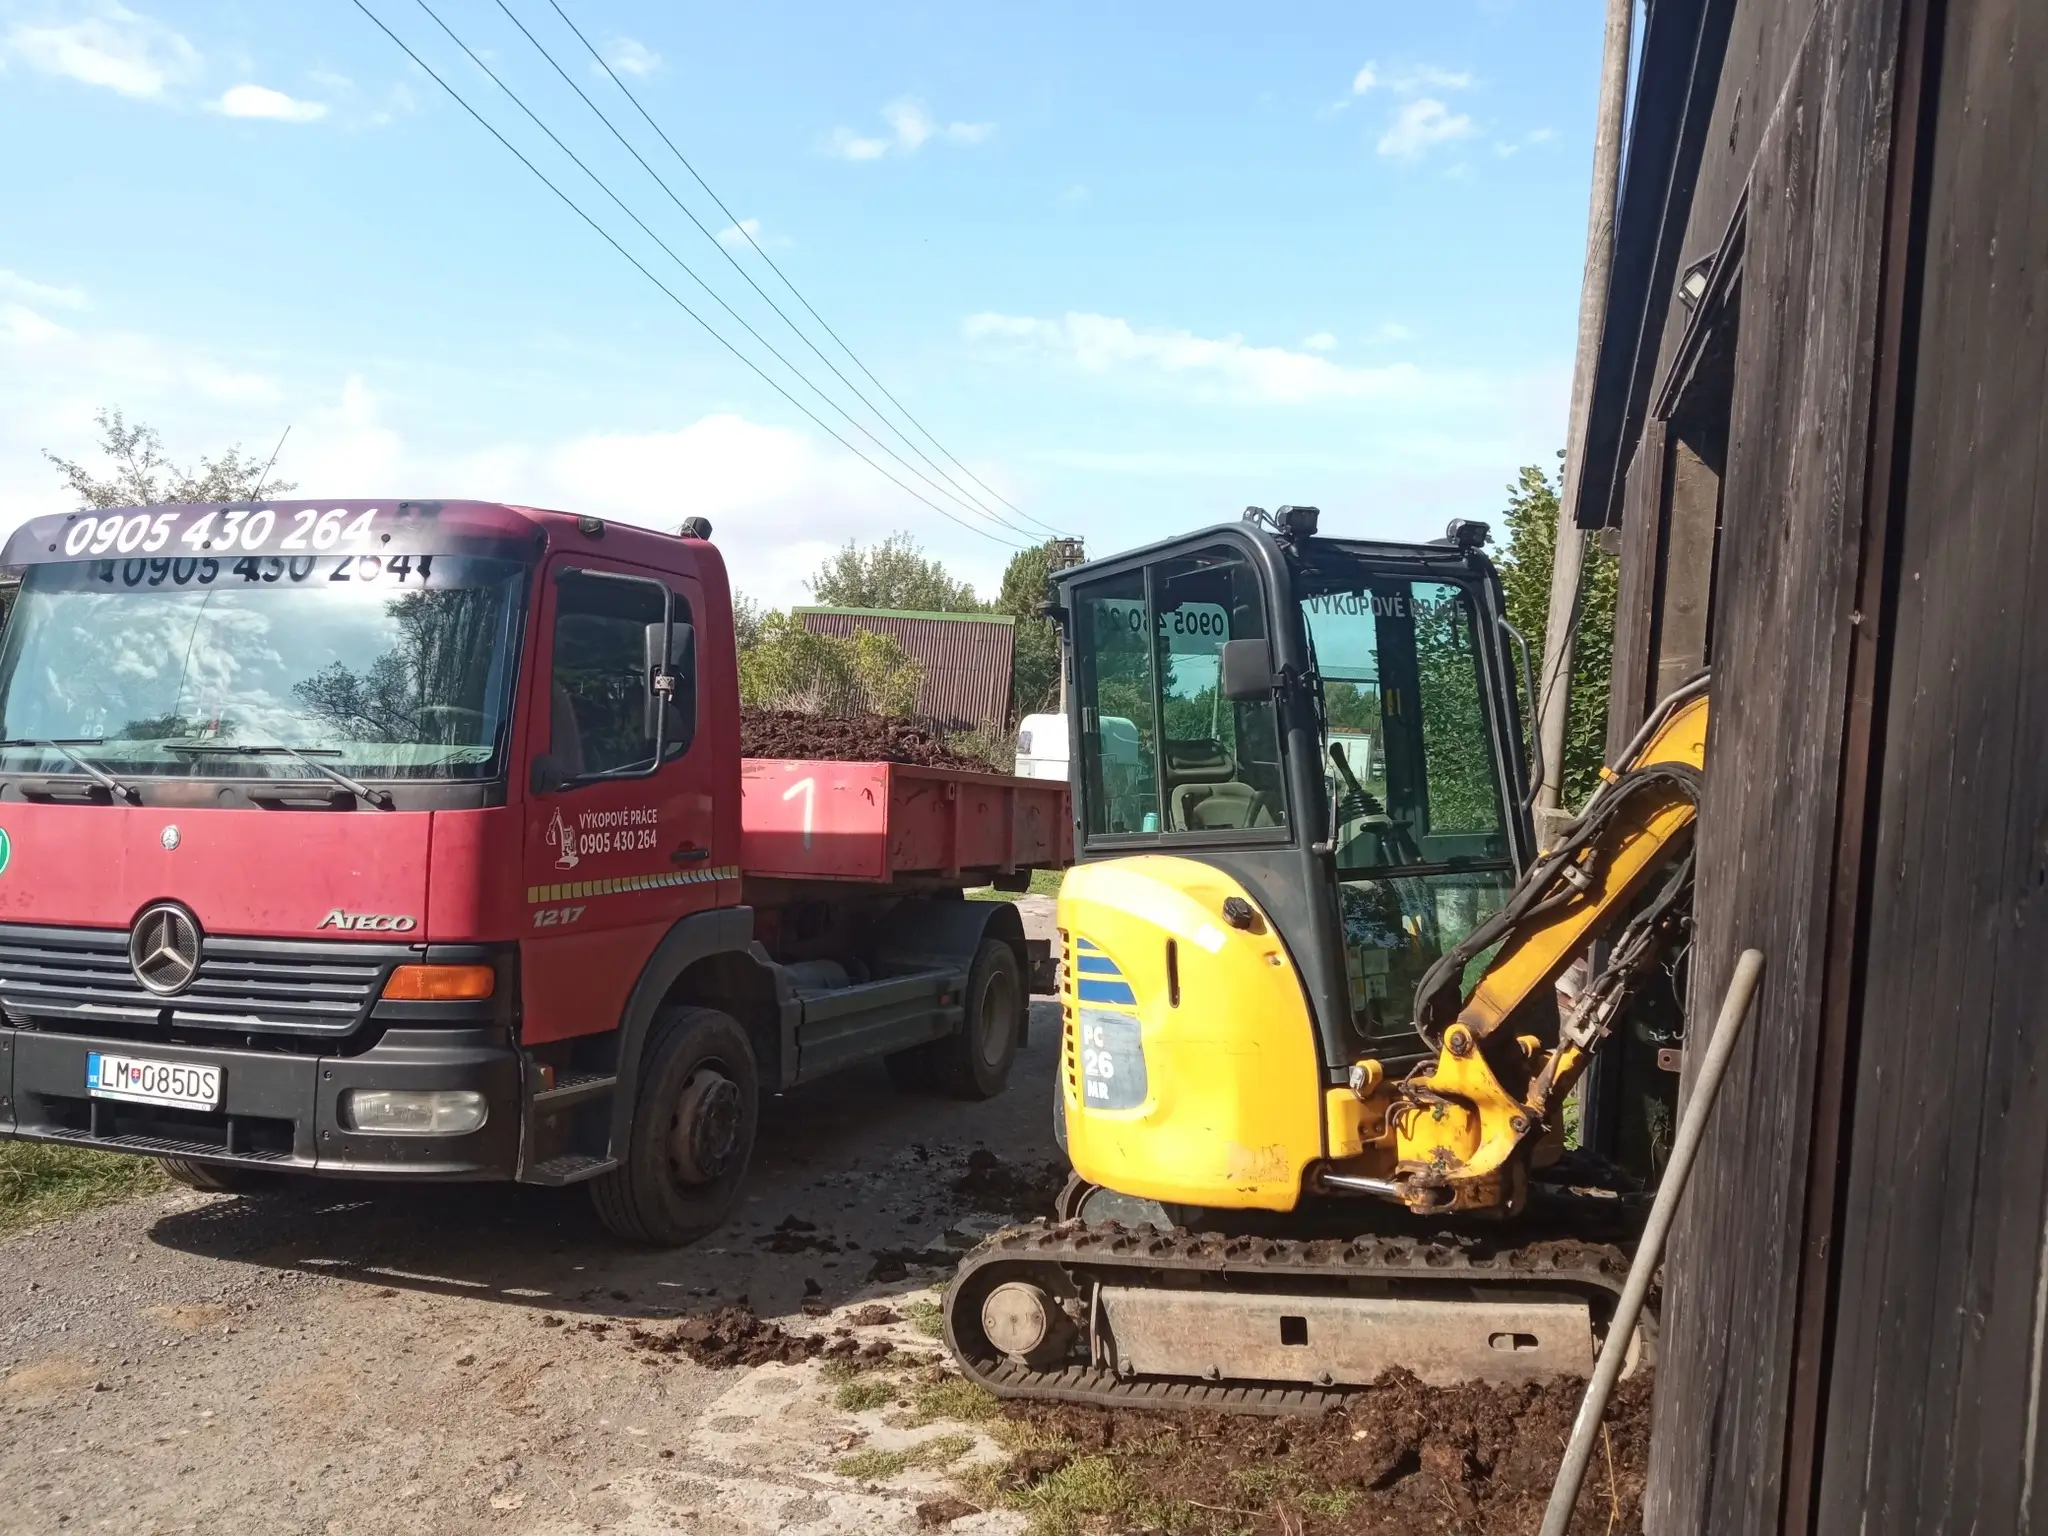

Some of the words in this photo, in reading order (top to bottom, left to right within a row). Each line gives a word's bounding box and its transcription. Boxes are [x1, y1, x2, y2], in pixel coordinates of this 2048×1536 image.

[66, 513, 180, 556] 0905
[181, 509, 276, 551] 430
[280, 508, 379, 550] 264
[1307, 588, 1406, 617] VÝKOPOVÉ
[579, 806, 629, 830] VÝKOPOVÉ
[630, 805, 658, 825] PRÁCE
[782, 777, 815, 853] 1
[580, 834, 611, 855] 0905
[613, 831, 635, 851] 430
[637, 829, 657, 849] 264
[533, 905, 587, 928] 1217
[1083, 1024, 1104, 1048] PC
[1084, 1048, 1114, 1079] 26
[1087, 1079, 1109, 1100] MR
